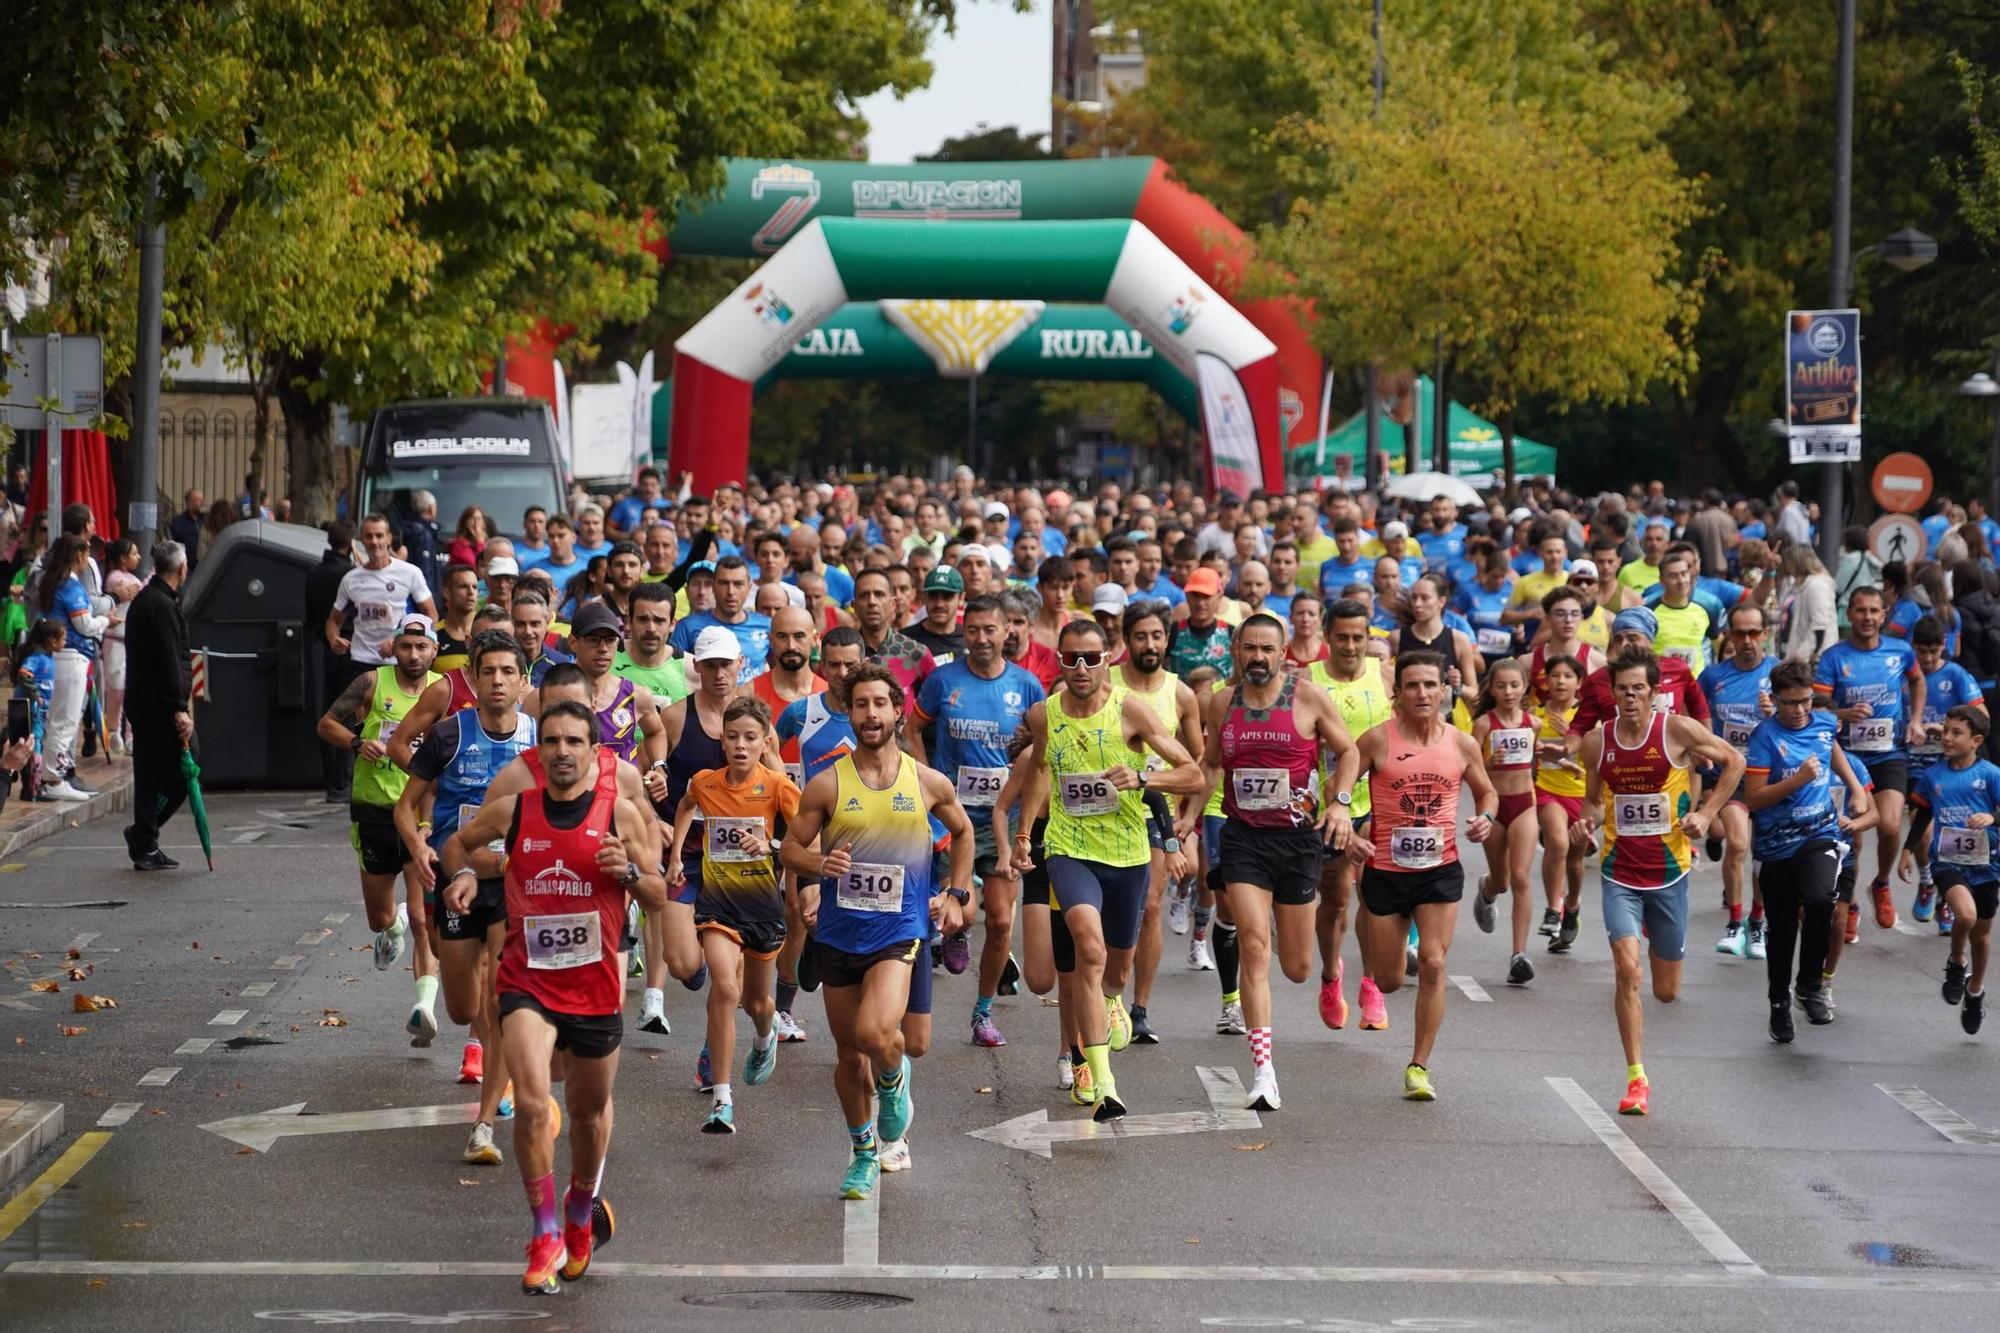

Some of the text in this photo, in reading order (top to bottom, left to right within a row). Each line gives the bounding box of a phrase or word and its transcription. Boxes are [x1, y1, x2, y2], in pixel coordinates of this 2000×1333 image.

[1040, 329, 1153, 358] RURAL
[949, 718, 969, 731] XIV
[1858, 726, 1886, 737] 748
[1240, 731, 1291, 742] APIS DURI
[967, 776, 1001, 791] 733
[1068, 782, 1107, 799] 596
[1242, 779, 1279, 794] 577
[1623, 804, 1660, 819] 615
[1401, 838, 1436, 852] 682
[1954, 836, 1976, 850] 13
[525, 879, 592, 897] CECINAS PABLO
[849, 873, 893, 893] 510
[538, 926, 588, 948] 638
